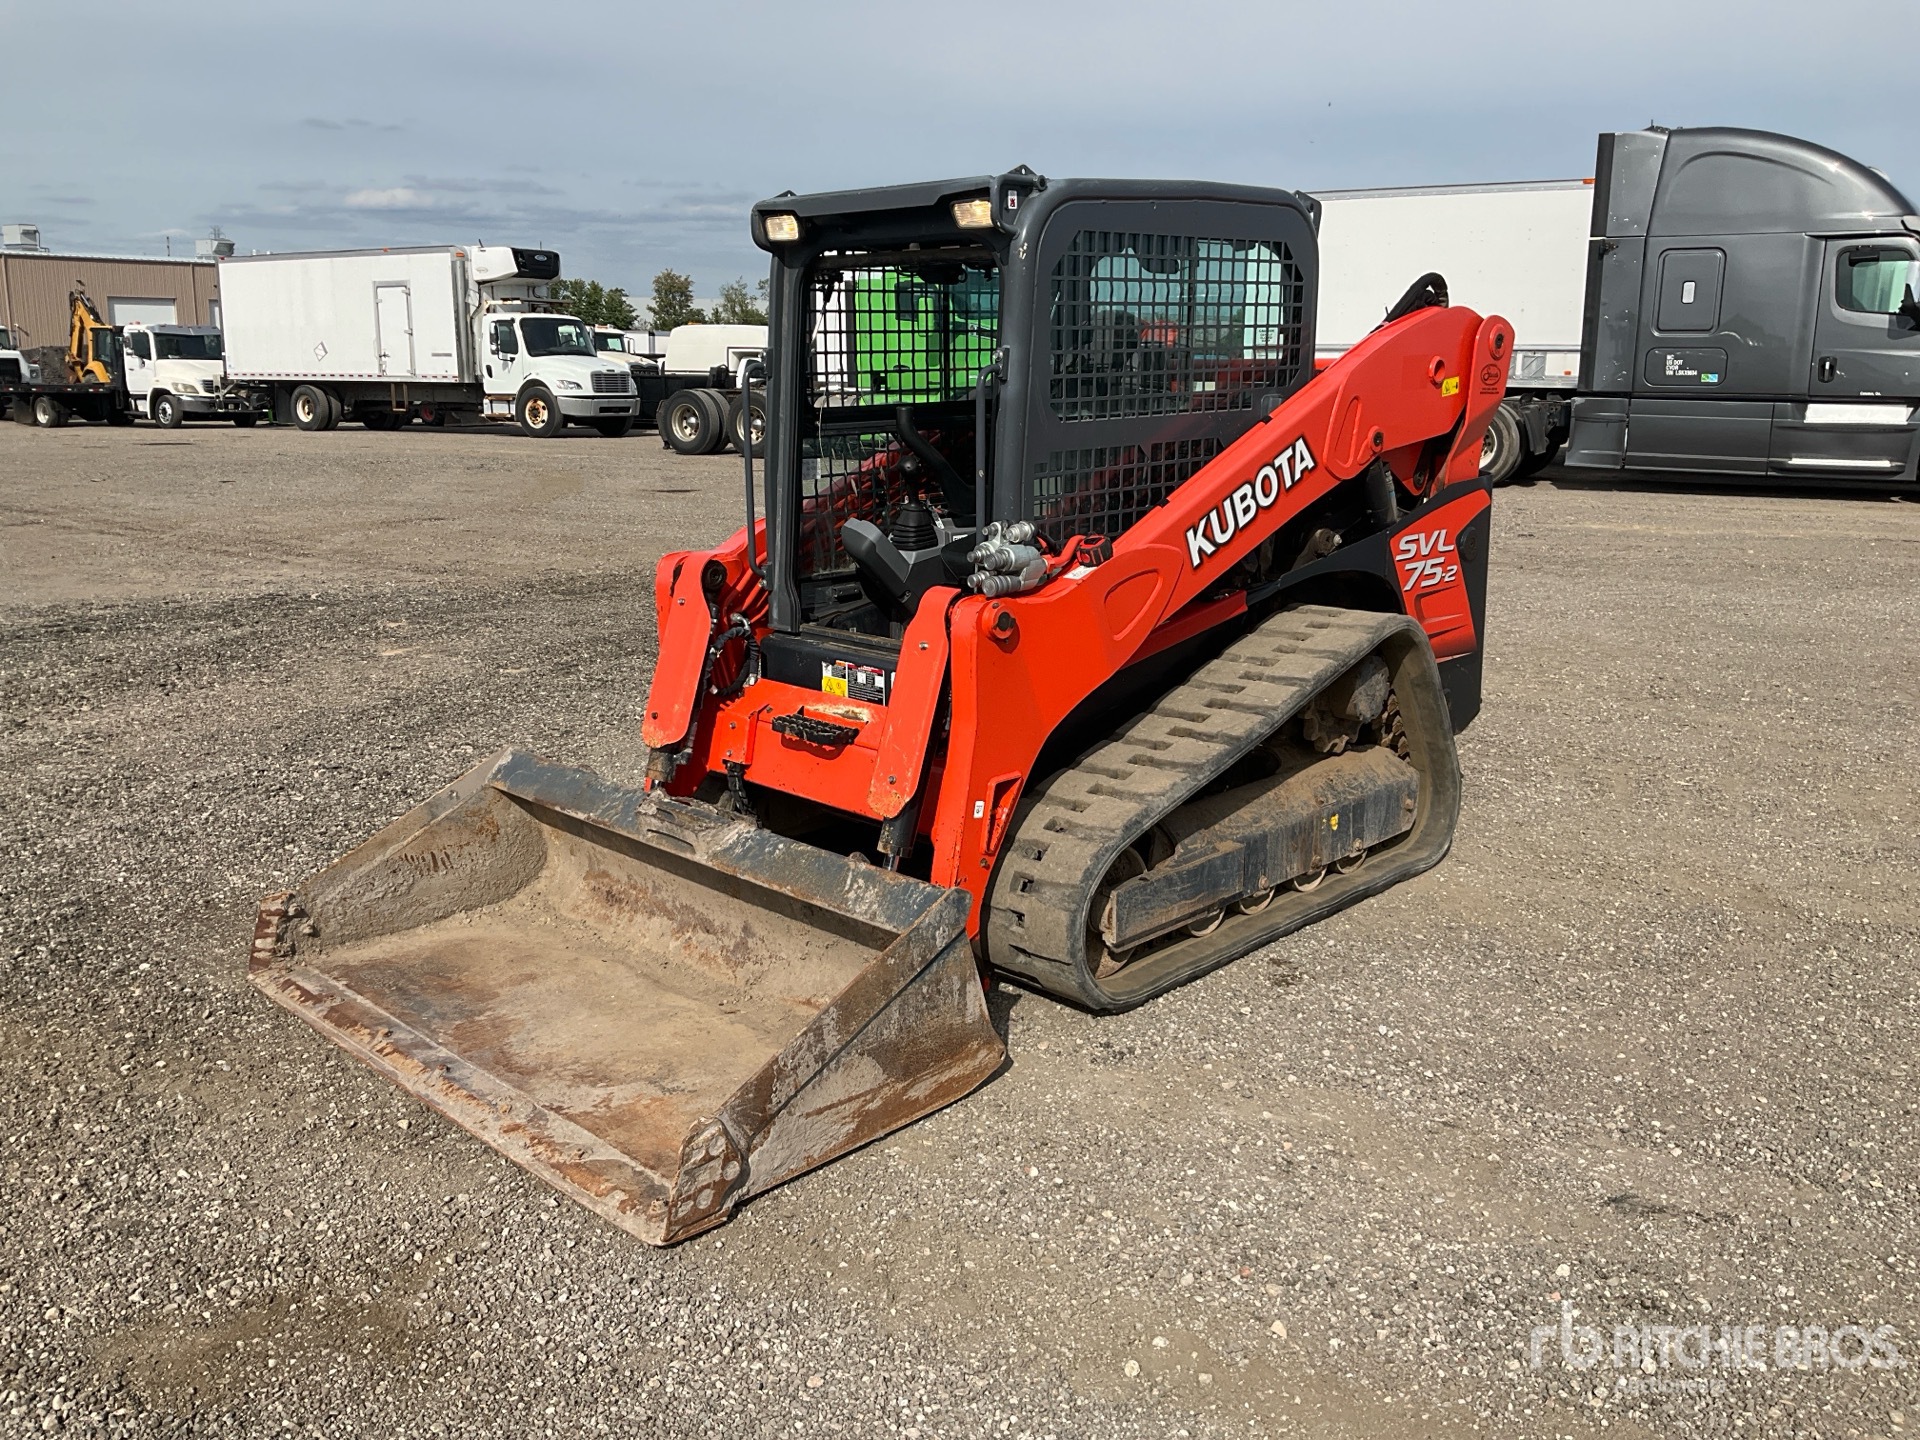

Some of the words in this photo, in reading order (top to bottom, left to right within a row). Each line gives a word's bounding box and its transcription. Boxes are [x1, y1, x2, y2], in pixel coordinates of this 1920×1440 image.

[1185, 437, 1316, 568] KUBOTA
[1395, 529, 1455, 561] SVL
[1403, 556, 1458, 591] 75-2
